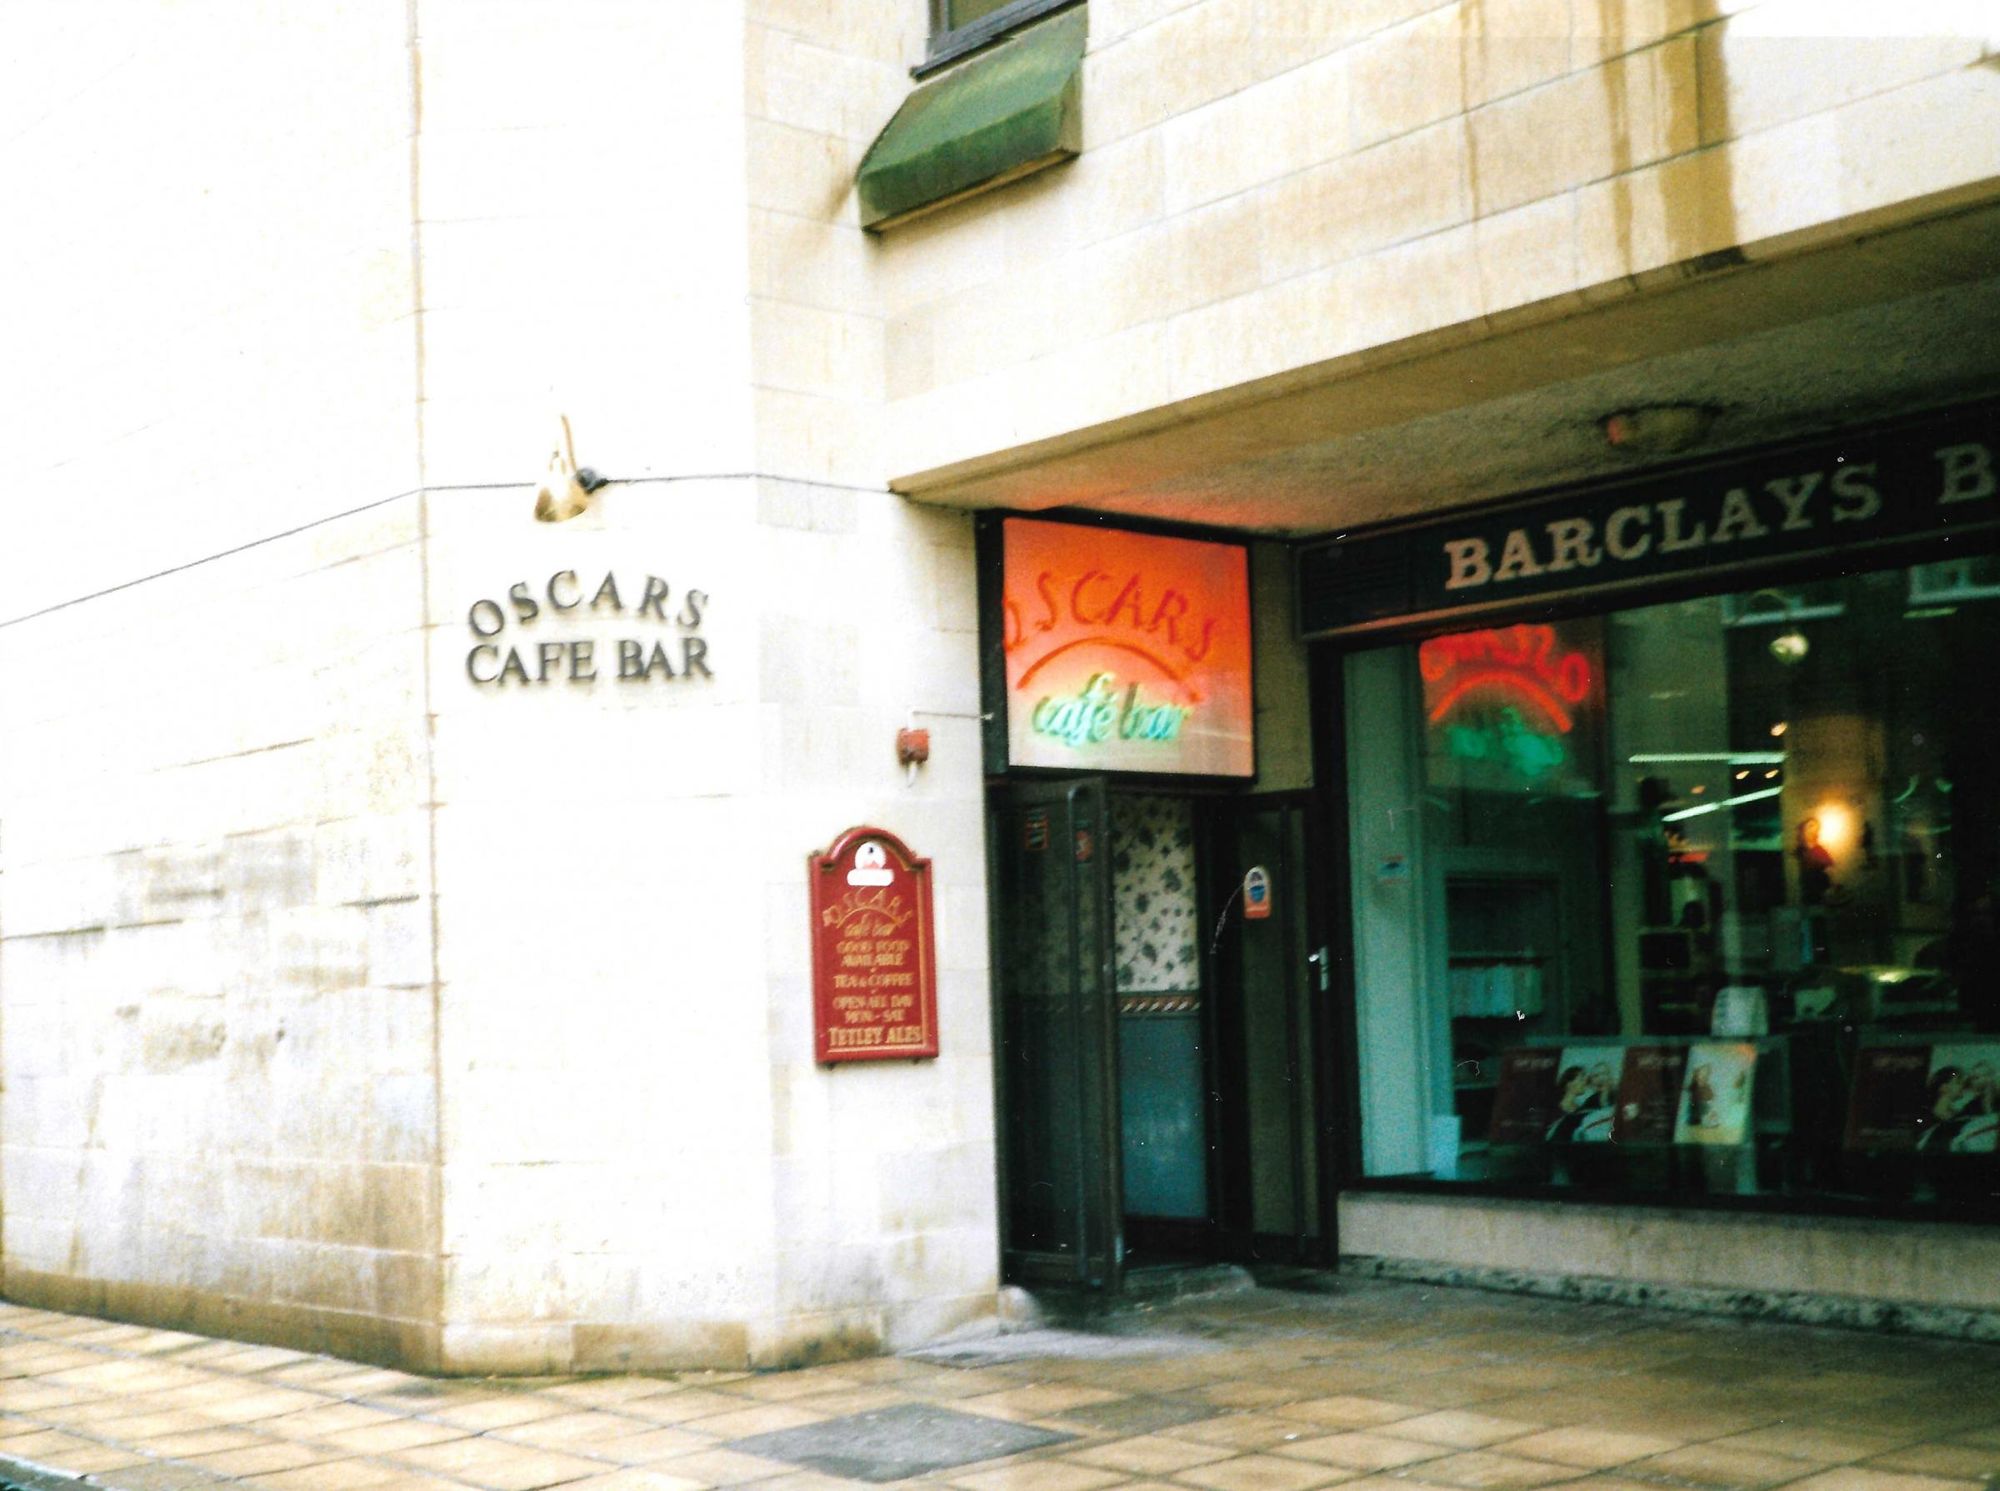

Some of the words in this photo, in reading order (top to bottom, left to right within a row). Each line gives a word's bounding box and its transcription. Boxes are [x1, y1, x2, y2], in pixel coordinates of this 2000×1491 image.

[1443, 462, 1882, 590] BARCLAYS
[468, 569, 709, 638] OSCARS
[466, 641, 598, 686] CAFE
[617, 636, 714, 682] BAR
[1119, 682, 1194, 741] bar
[828, 1026, 884, 1046] TETLEY
